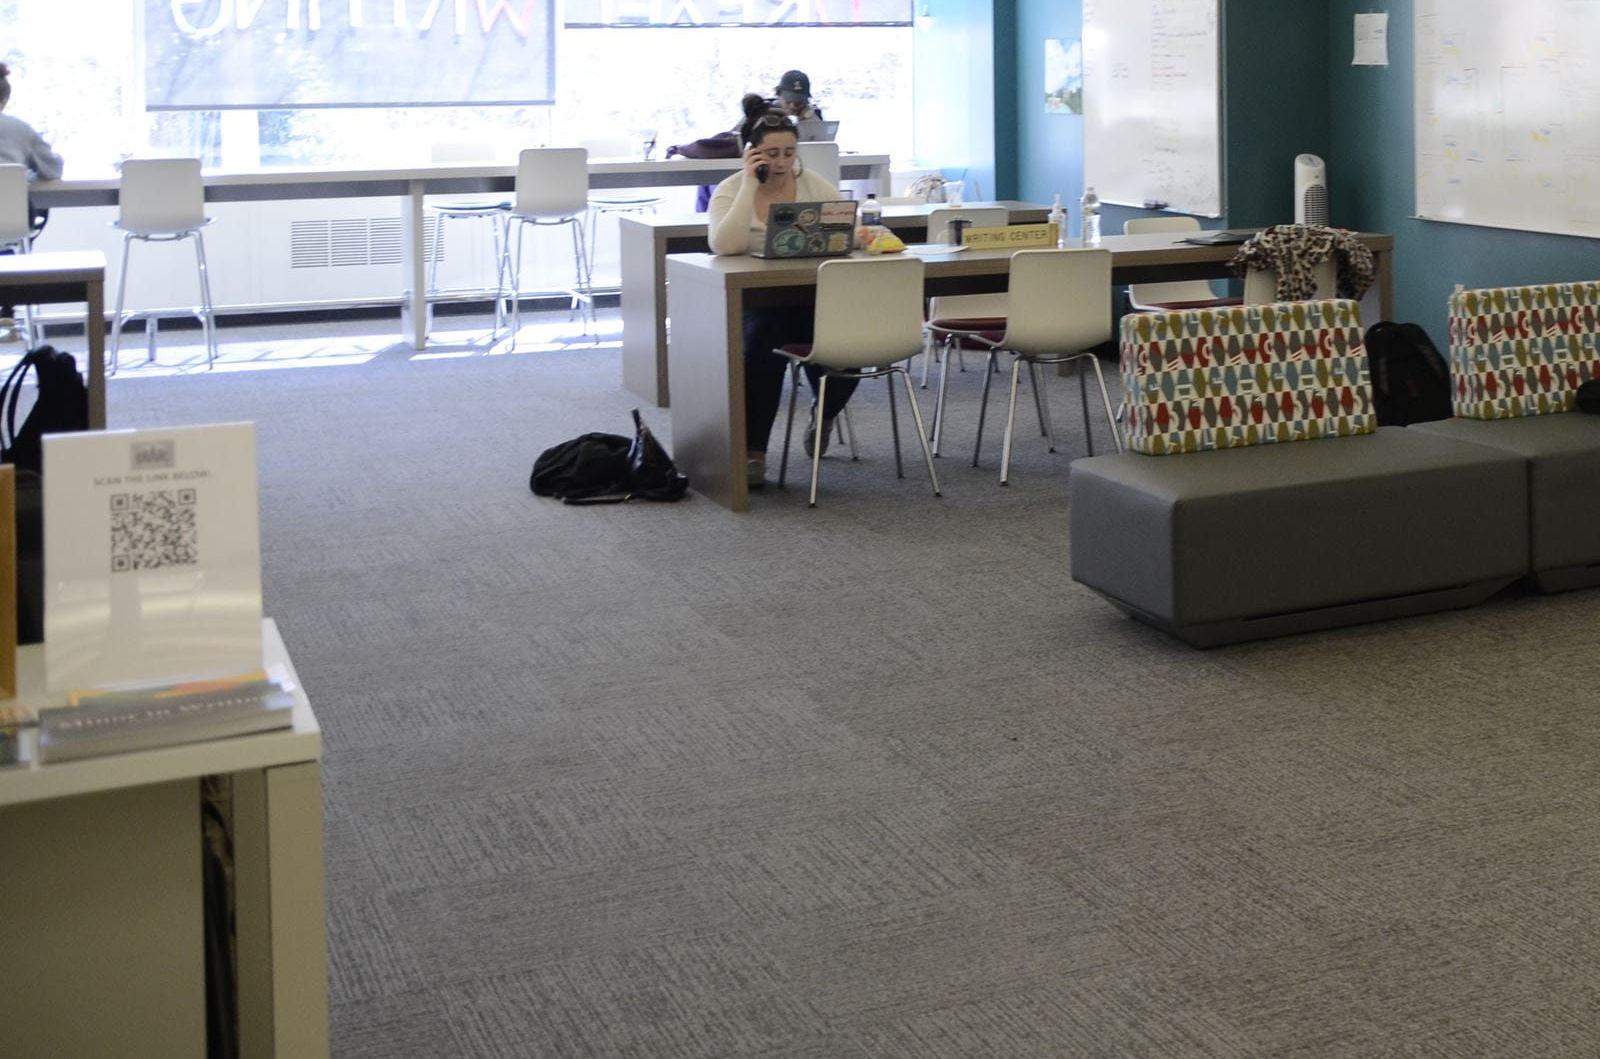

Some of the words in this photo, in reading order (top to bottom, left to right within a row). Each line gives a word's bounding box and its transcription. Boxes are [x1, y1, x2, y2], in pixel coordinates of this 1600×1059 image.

[965, 231, 1006, 244] WRITING
[1009, 229, 1047, 242] CENTER
[93, 477, 122, 486] SCAN
[124, 475, 143, 483] THE
[178, 695, 263, 713] Writin
